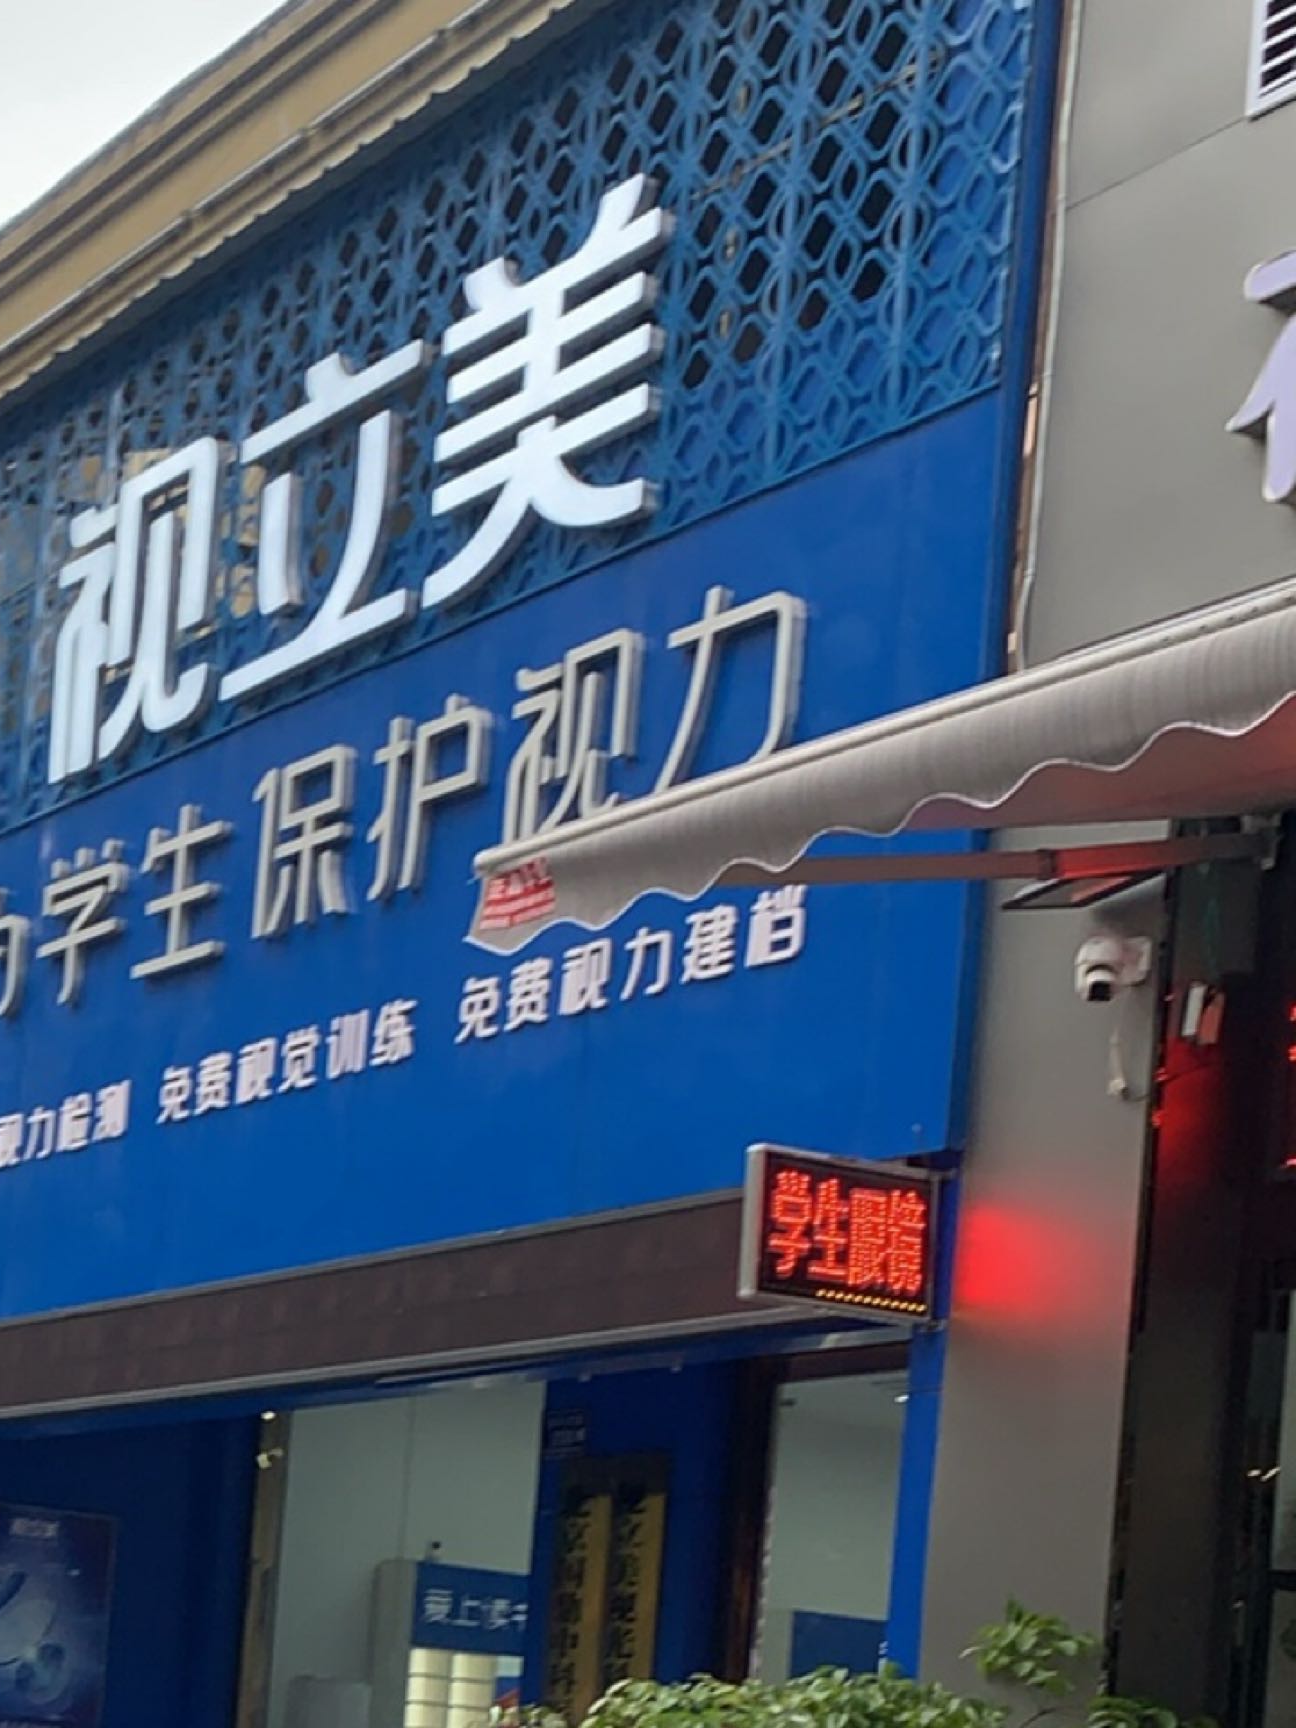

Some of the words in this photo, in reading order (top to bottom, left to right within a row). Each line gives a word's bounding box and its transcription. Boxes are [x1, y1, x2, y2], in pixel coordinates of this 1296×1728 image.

[47, 172, 668, 785] 视立美
[454, 886, 807, 1044] 免费视力建档
[157, 999, 418, 1122] 免费视觉训练
